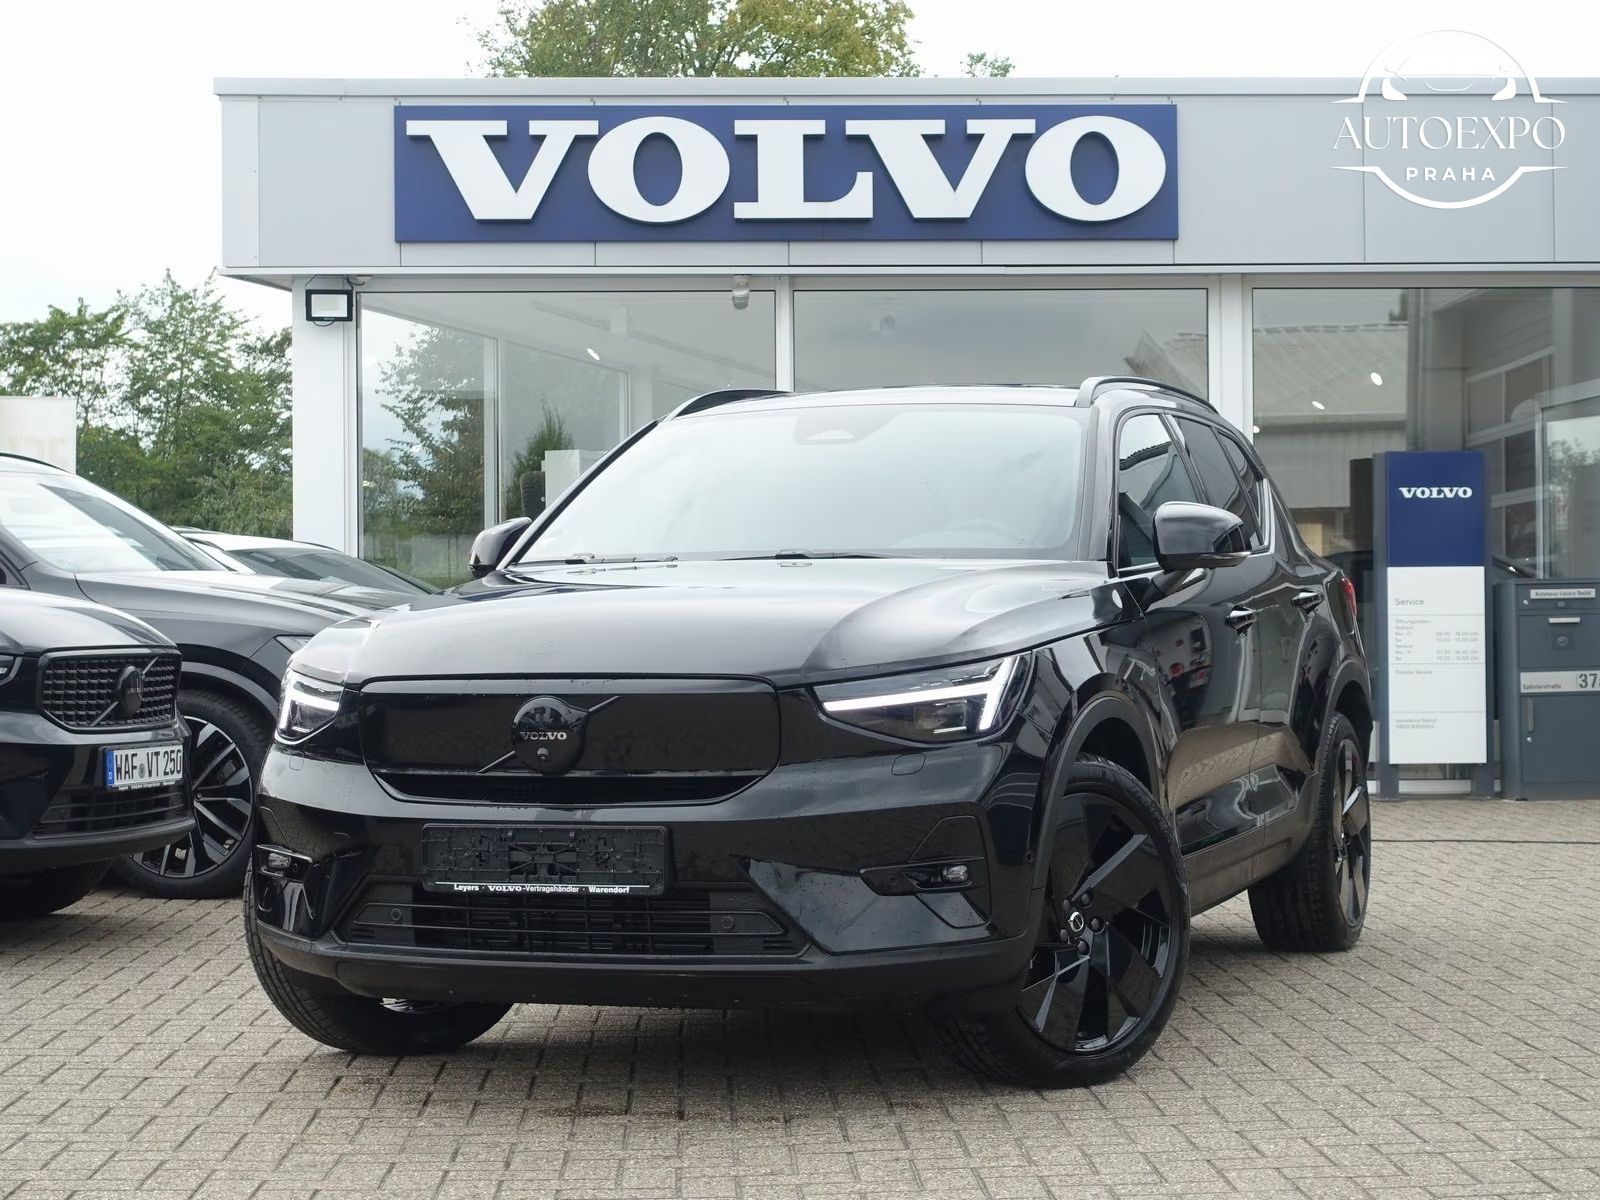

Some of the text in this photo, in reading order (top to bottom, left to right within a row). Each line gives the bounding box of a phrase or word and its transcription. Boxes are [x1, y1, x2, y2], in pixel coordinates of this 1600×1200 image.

[405, 115, 1167, 224] VOLVO
[1398, 486, 1473, 499] VOLVO
[1394, 598, 1425, 606] Service
[1579, 673, 1600, 689] 37
[520, 731, 567, 740] VOLVO
[115, 748, 182, 781] WAF VT 250
[454, 884, 480, 892] Leyers
